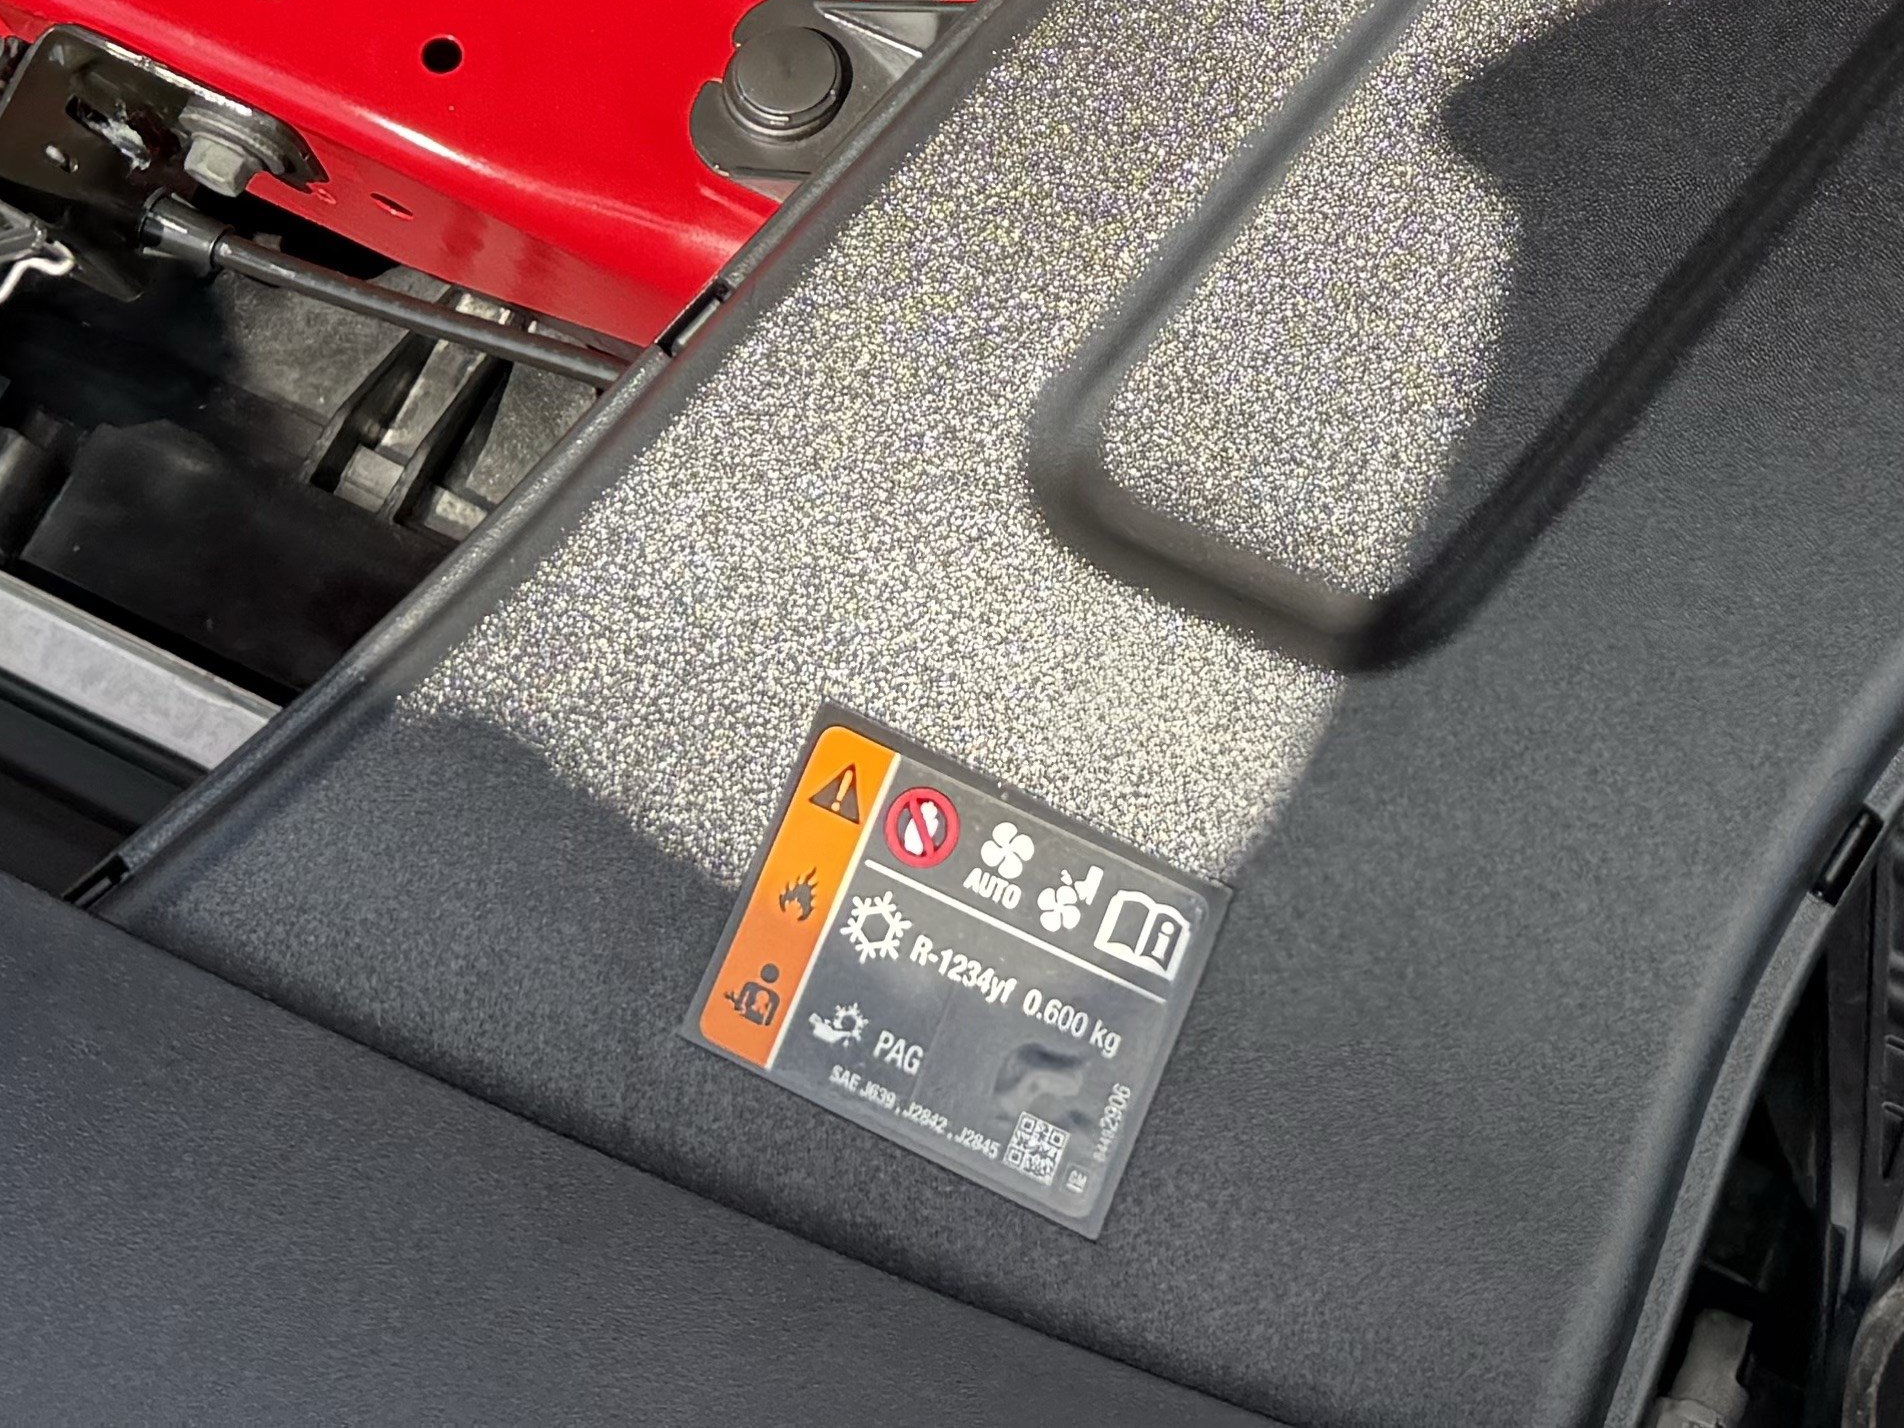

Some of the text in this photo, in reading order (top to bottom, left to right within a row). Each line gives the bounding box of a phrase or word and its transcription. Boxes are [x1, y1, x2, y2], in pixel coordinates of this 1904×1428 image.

[963, 868, 1021, 909] AUTO
[910, 935, 1121, 1058] R-1234yf 0.600 kg
[874, 1031, 923, 1074] PAG
[830, 1065, 861, 1092] SAE
[955, 1127, 1000, 1159] J2845
